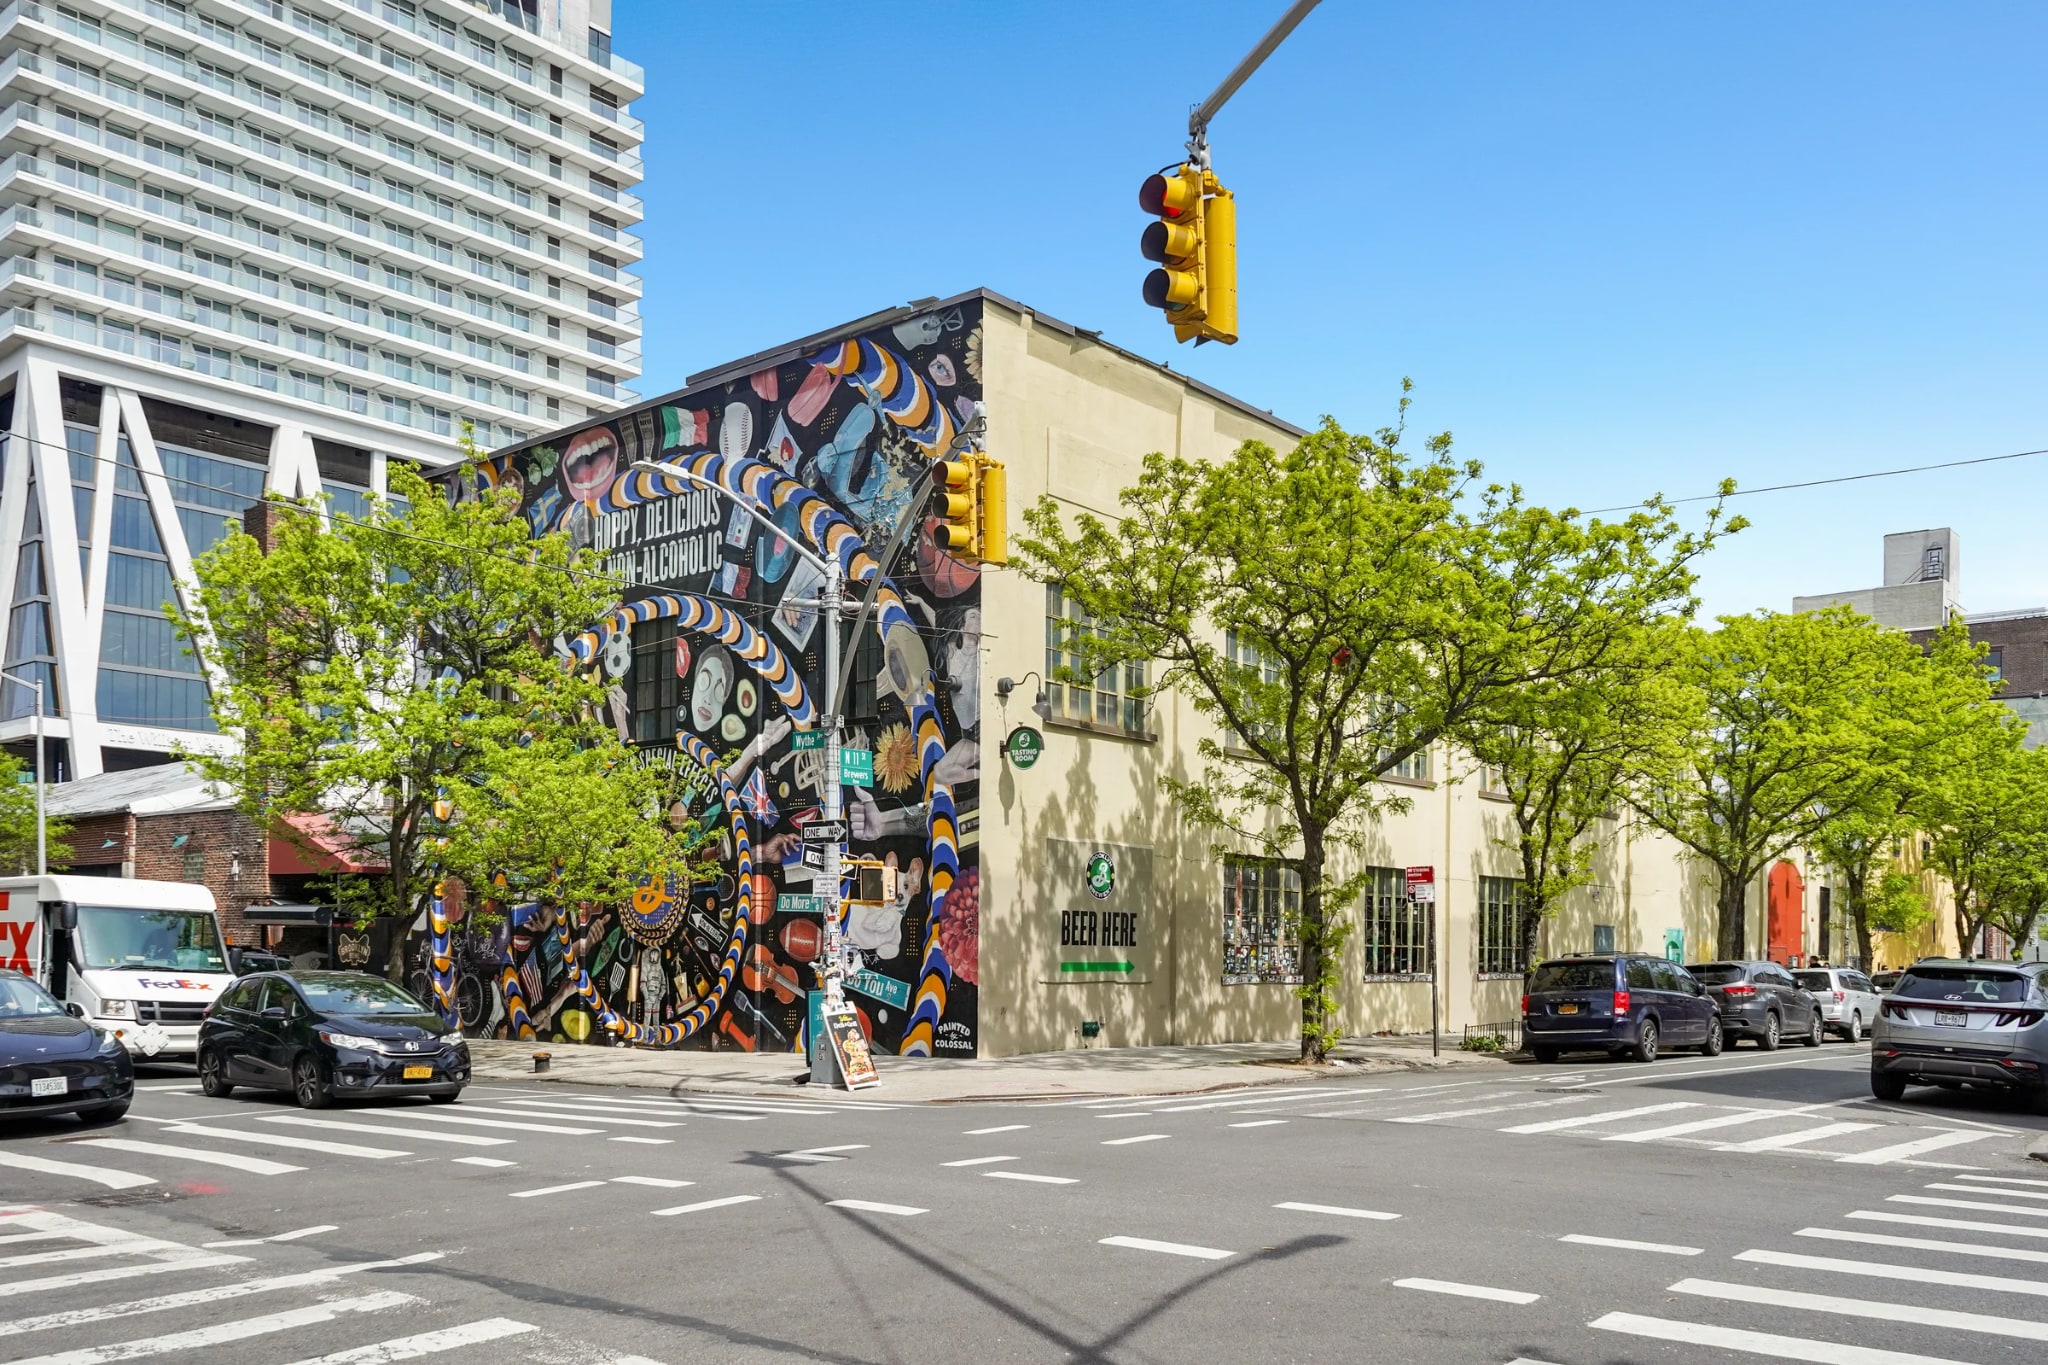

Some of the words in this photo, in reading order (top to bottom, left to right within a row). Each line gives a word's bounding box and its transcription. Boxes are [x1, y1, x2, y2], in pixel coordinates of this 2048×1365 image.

[594, 506, 642, 553] HOPPY,
[645, 487, 720, 541] DELICIOUS
[795, 734, 815, 750] Wythe
[845, 751, 850, 764] N
[853, 752, 860, 766] 11
[1011, 748, 1038, 757] TASTING
[1014, 754, 1034, 762] ROOM
[844, 768, 868, 780] Brewers
[805, 828, 821, 838] ONE
[828, 826, 842, 837] WAY
[1089, 852, 1113, 868] BROOKLYN
[1089, 883, 1113, 898] BREWERY
[781, 896, 790, 909] Do
[791, 895, 810, 909] More
[1061, 910, 1098, 946] BEER
[1101, 911, 1137, 947] HERE
[340, 942, 369, 957] BROOKLYN
[137, 978, 214, 991] FedEx
[885, 981, 898, 994] Ave
[938, 1022, 971, 1037] PAINTED
[935, 1040, 974, 1050] COLOSSAL
